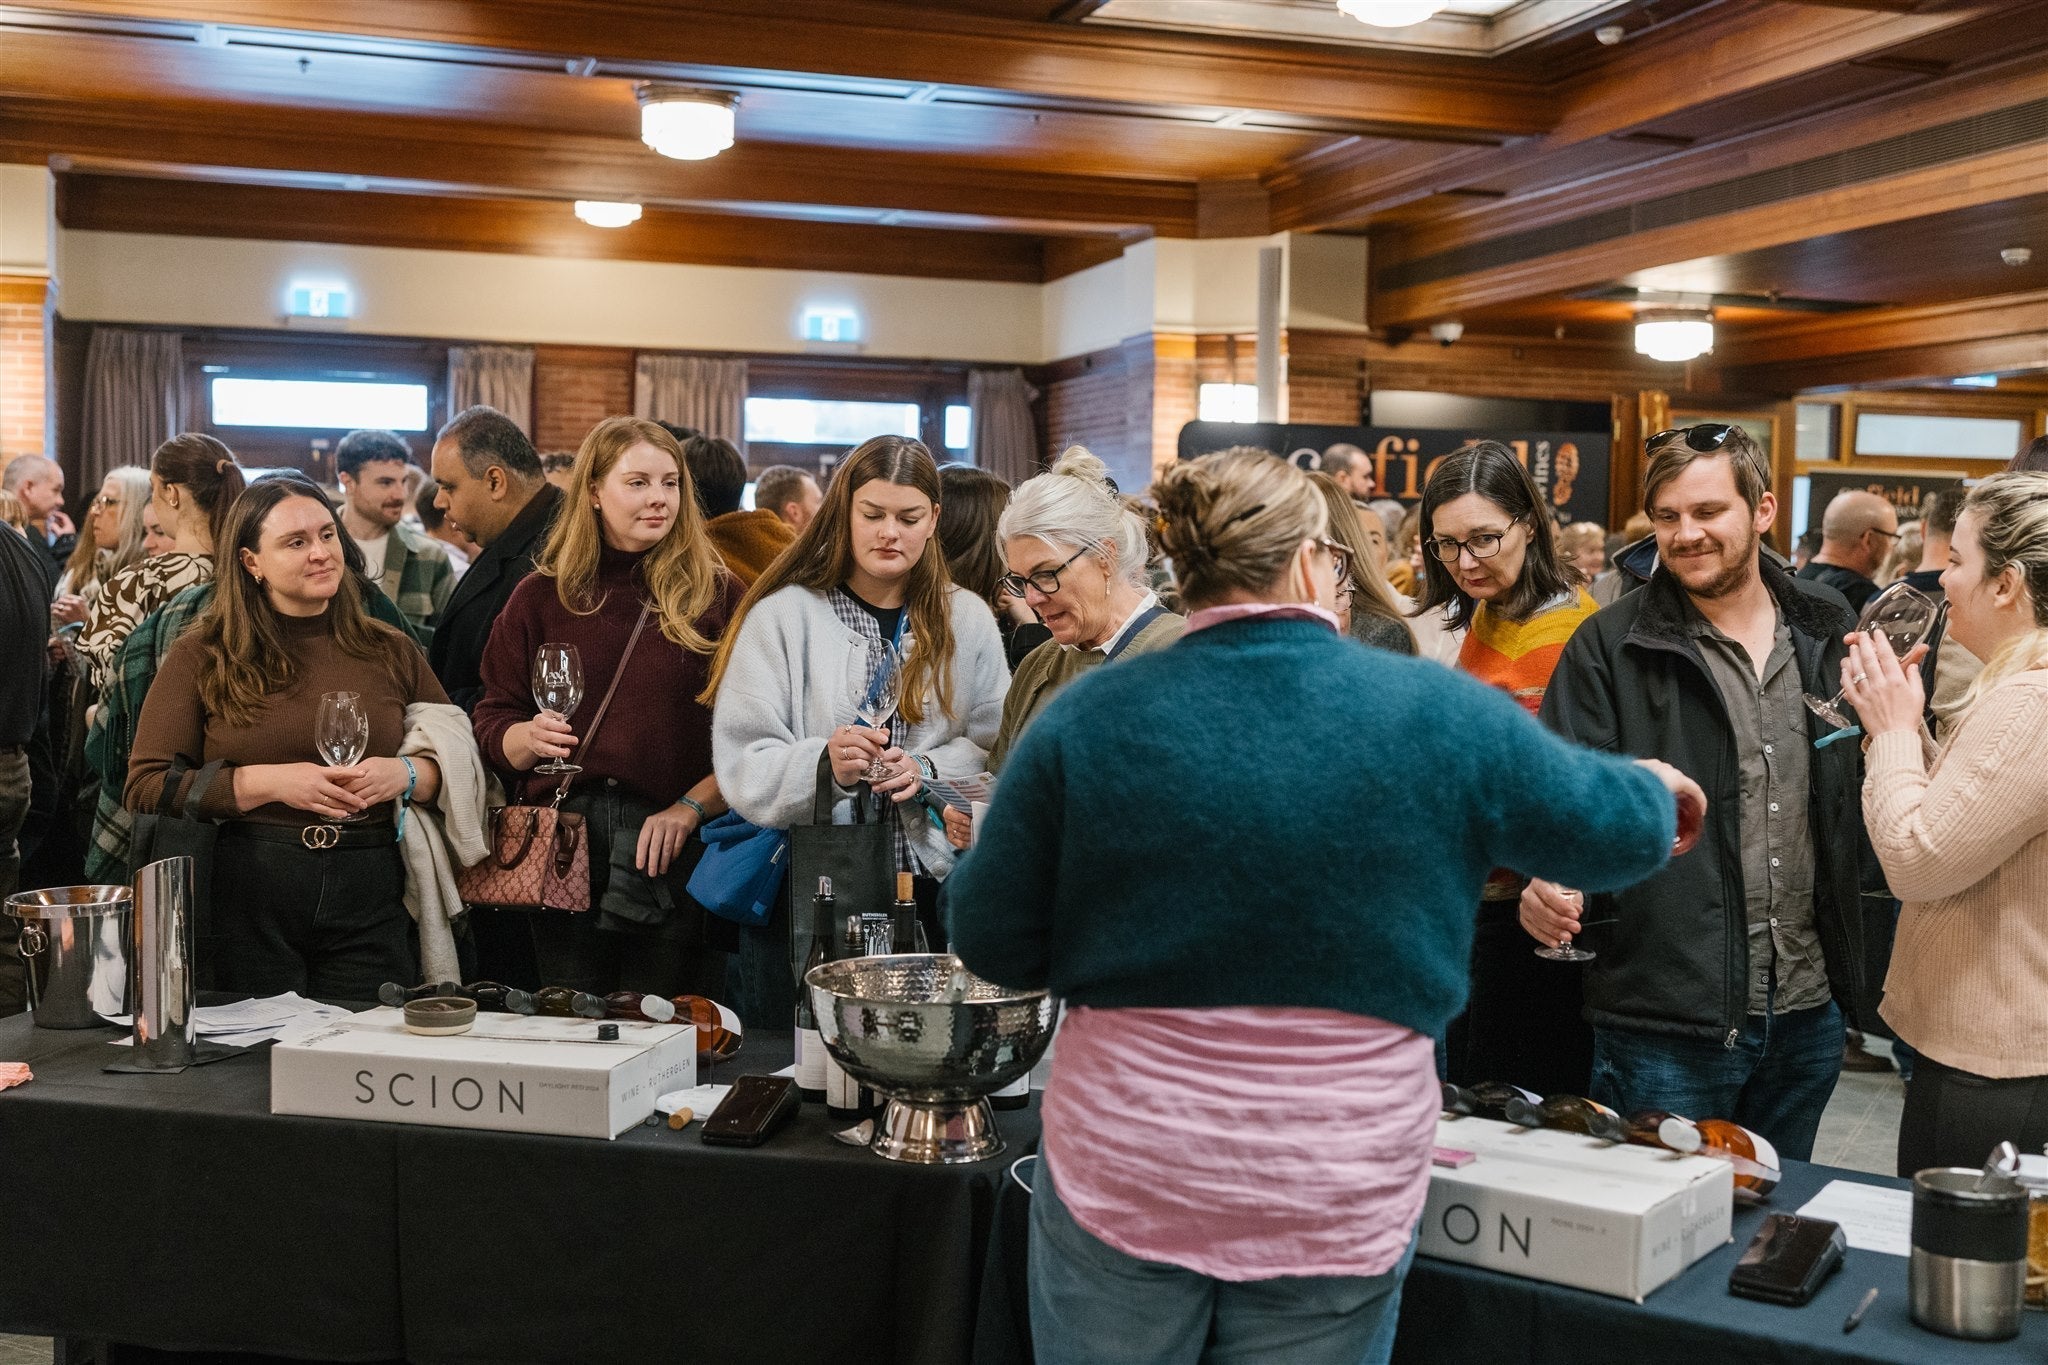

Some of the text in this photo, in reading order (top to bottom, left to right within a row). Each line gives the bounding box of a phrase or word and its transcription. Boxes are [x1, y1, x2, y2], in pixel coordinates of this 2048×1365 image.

[355, 1070, 524, 1115] SCION
[621, 1084, 641, 1103] WINE
[648, 1058, 691, 1088] RUTHERGLEN
